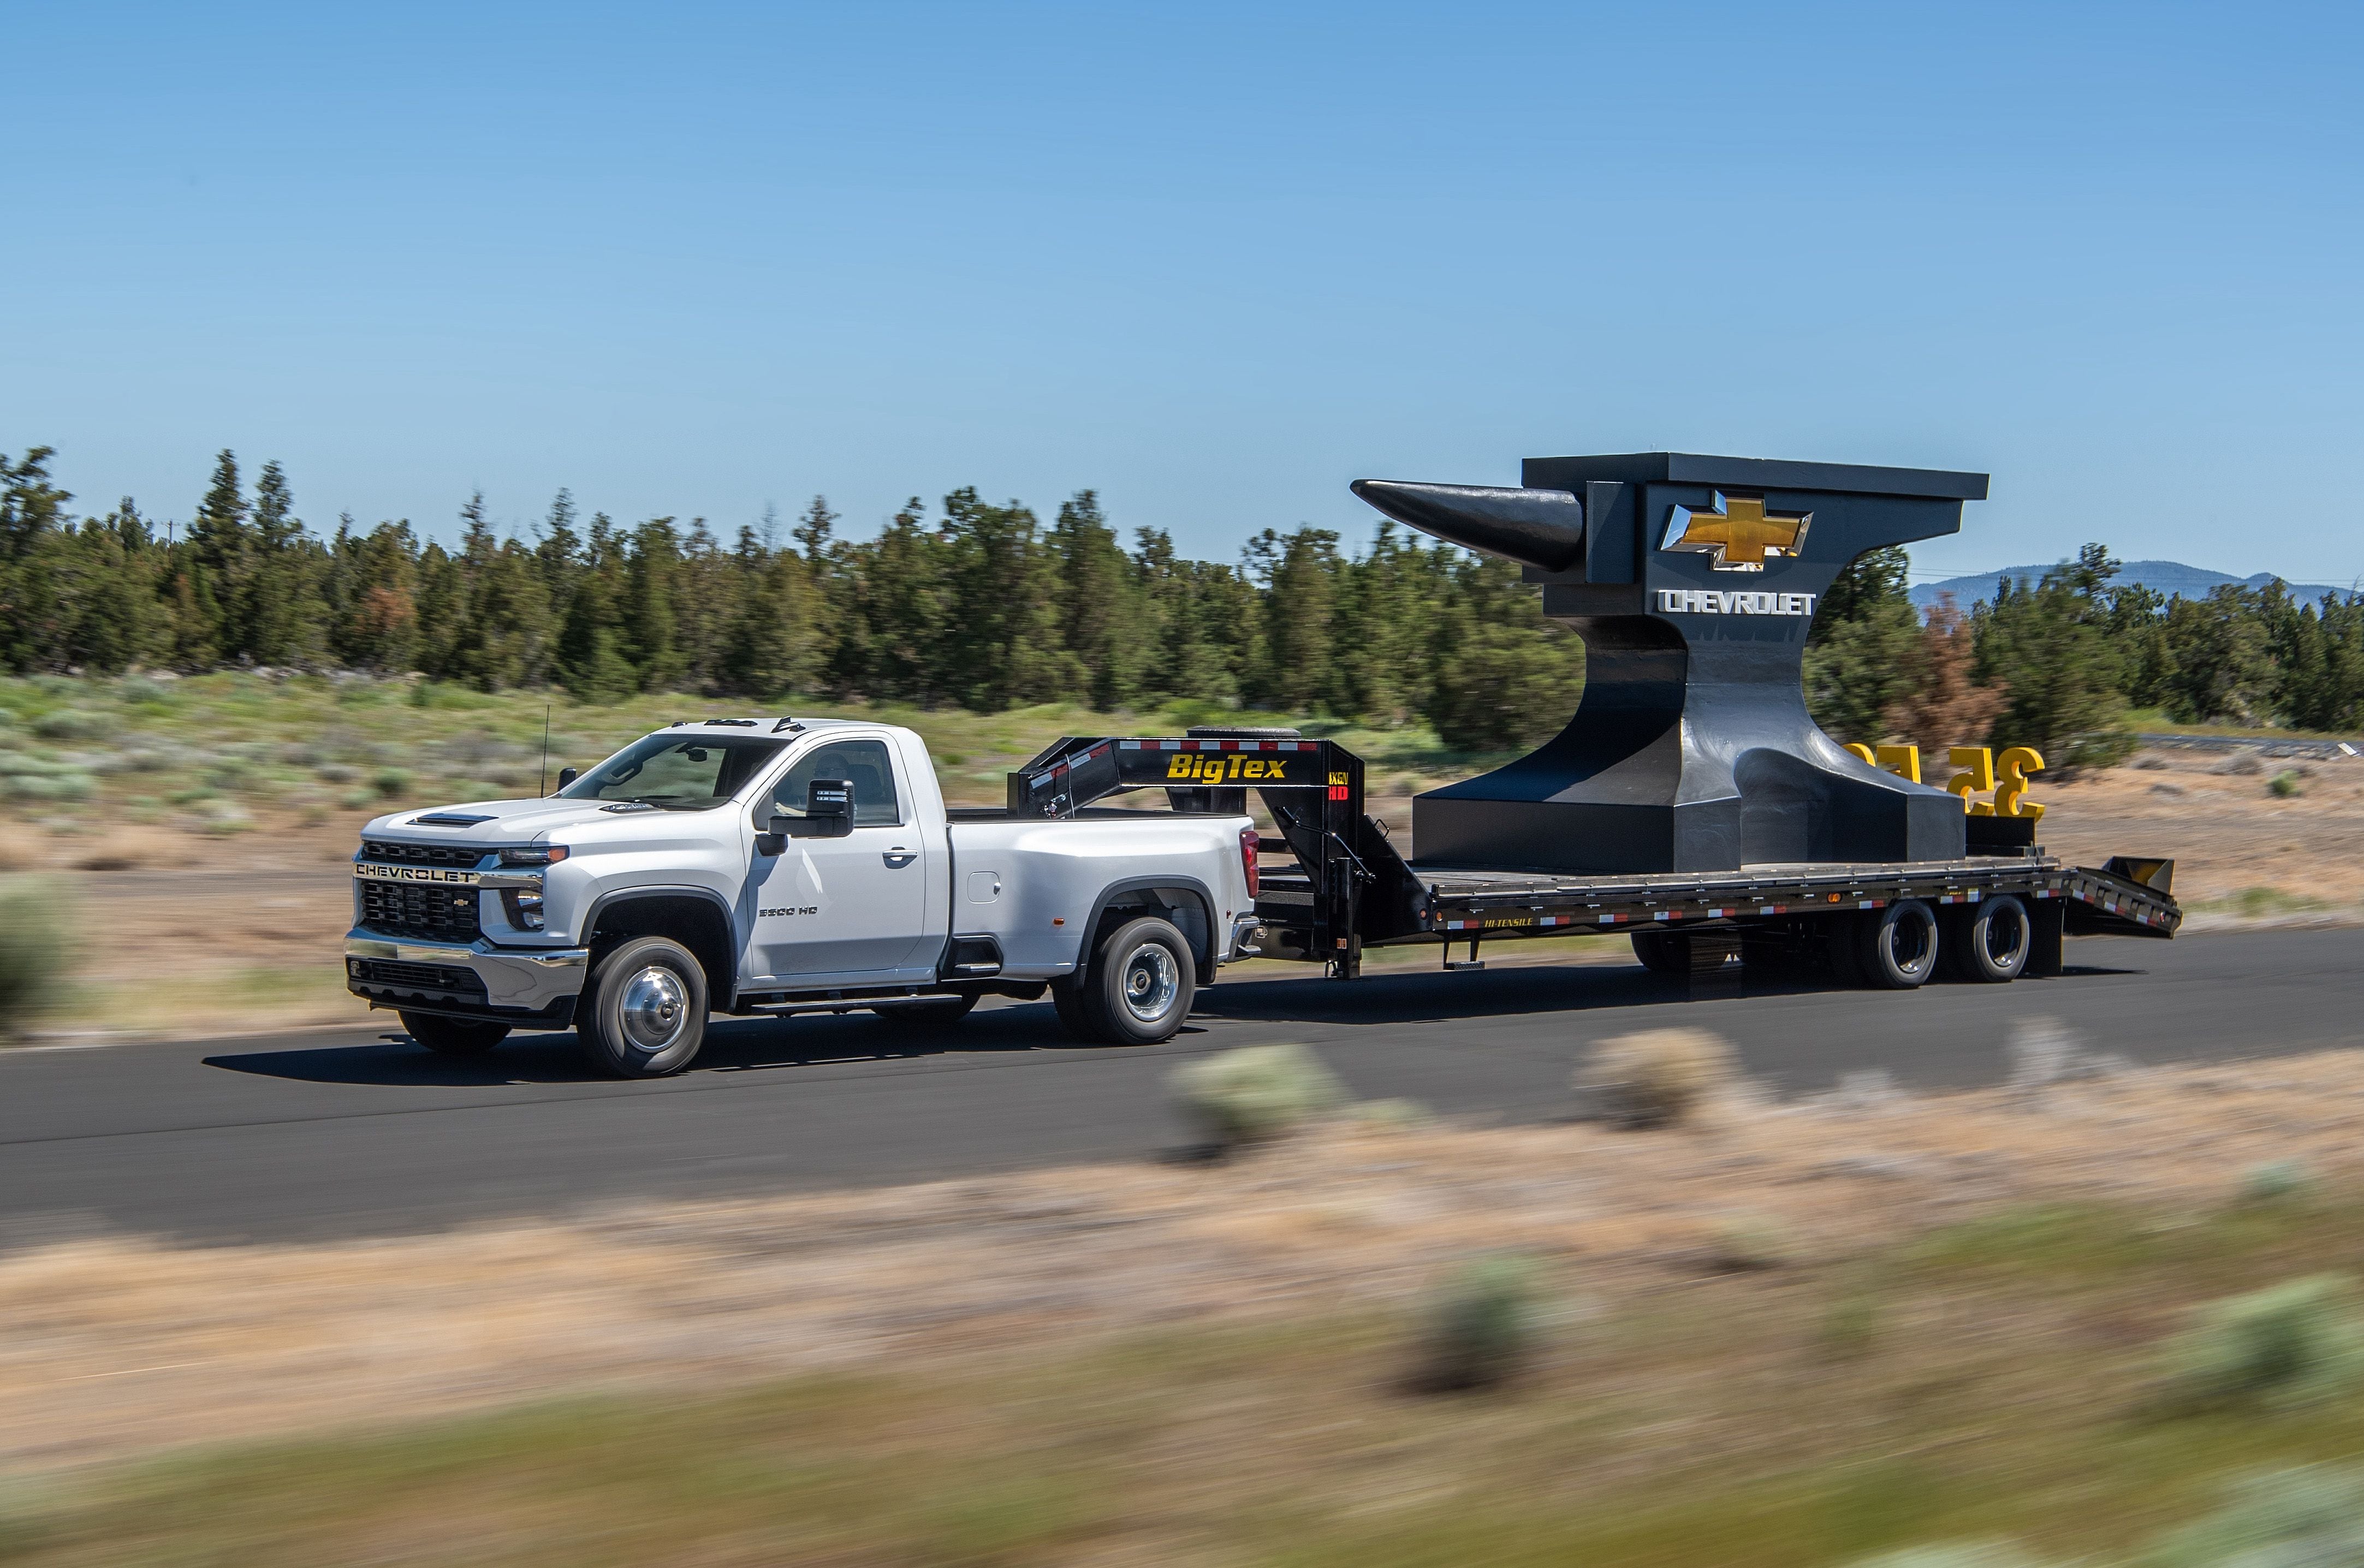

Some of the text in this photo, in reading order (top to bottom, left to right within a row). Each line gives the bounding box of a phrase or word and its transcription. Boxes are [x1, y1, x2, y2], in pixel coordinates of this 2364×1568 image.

[1658, 589, 1816, 616] CHEVROLET
[1167, 754, 1287, 784] BigTex
[1328, 786, 1349, 800] HD
[357, 864, 474, 883] CHEVROLET
[759, 906, 817, 917] 3500 HD
[1484, 917, 1533, 928] HI-TENSILE
